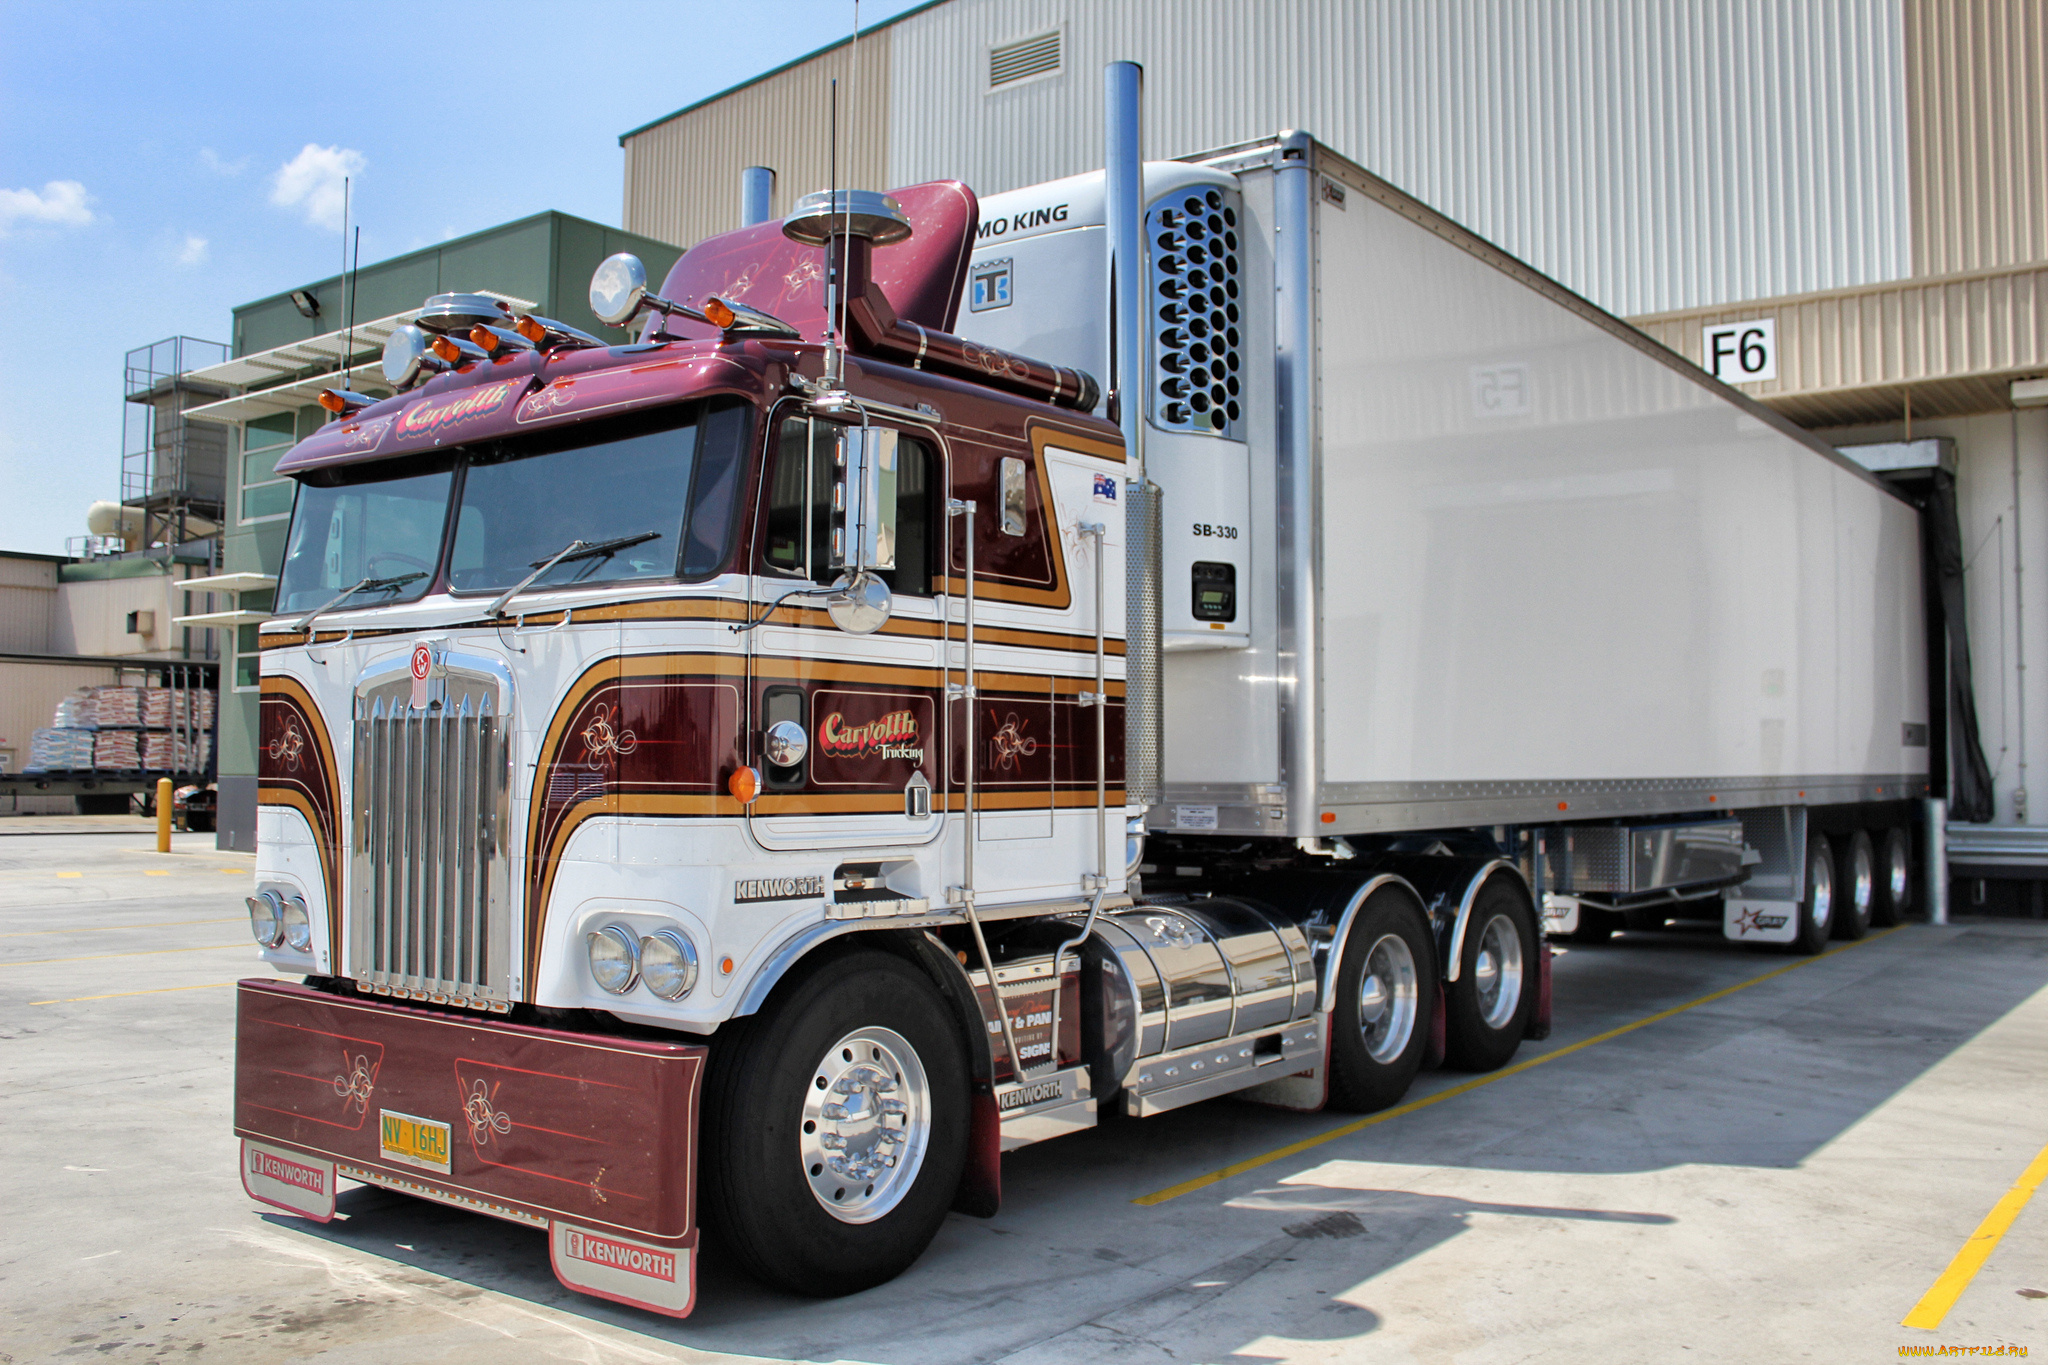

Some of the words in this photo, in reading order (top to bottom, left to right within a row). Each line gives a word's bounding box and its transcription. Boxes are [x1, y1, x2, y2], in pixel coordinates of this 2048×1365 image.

[1013, 204, 1068, 231] KING
[1711, 327, 1767, 376] F6
[1193, 523, 1238, 540] SB-330
[821, 711, 917, 752] Carvolth
[875, 741, 923, 768] Trucking
[735, 876, 825, 901] KENWORTH
[1000, 1081, 1062, 1109] KENWORTH
[383, 1115, 401, 1144] NV
[412, 1123, 447, 1155] 16HJ
[265, 1157, 322, 1189] KENWORTH
[585, 1239, 673, 1277] KENWORTH
